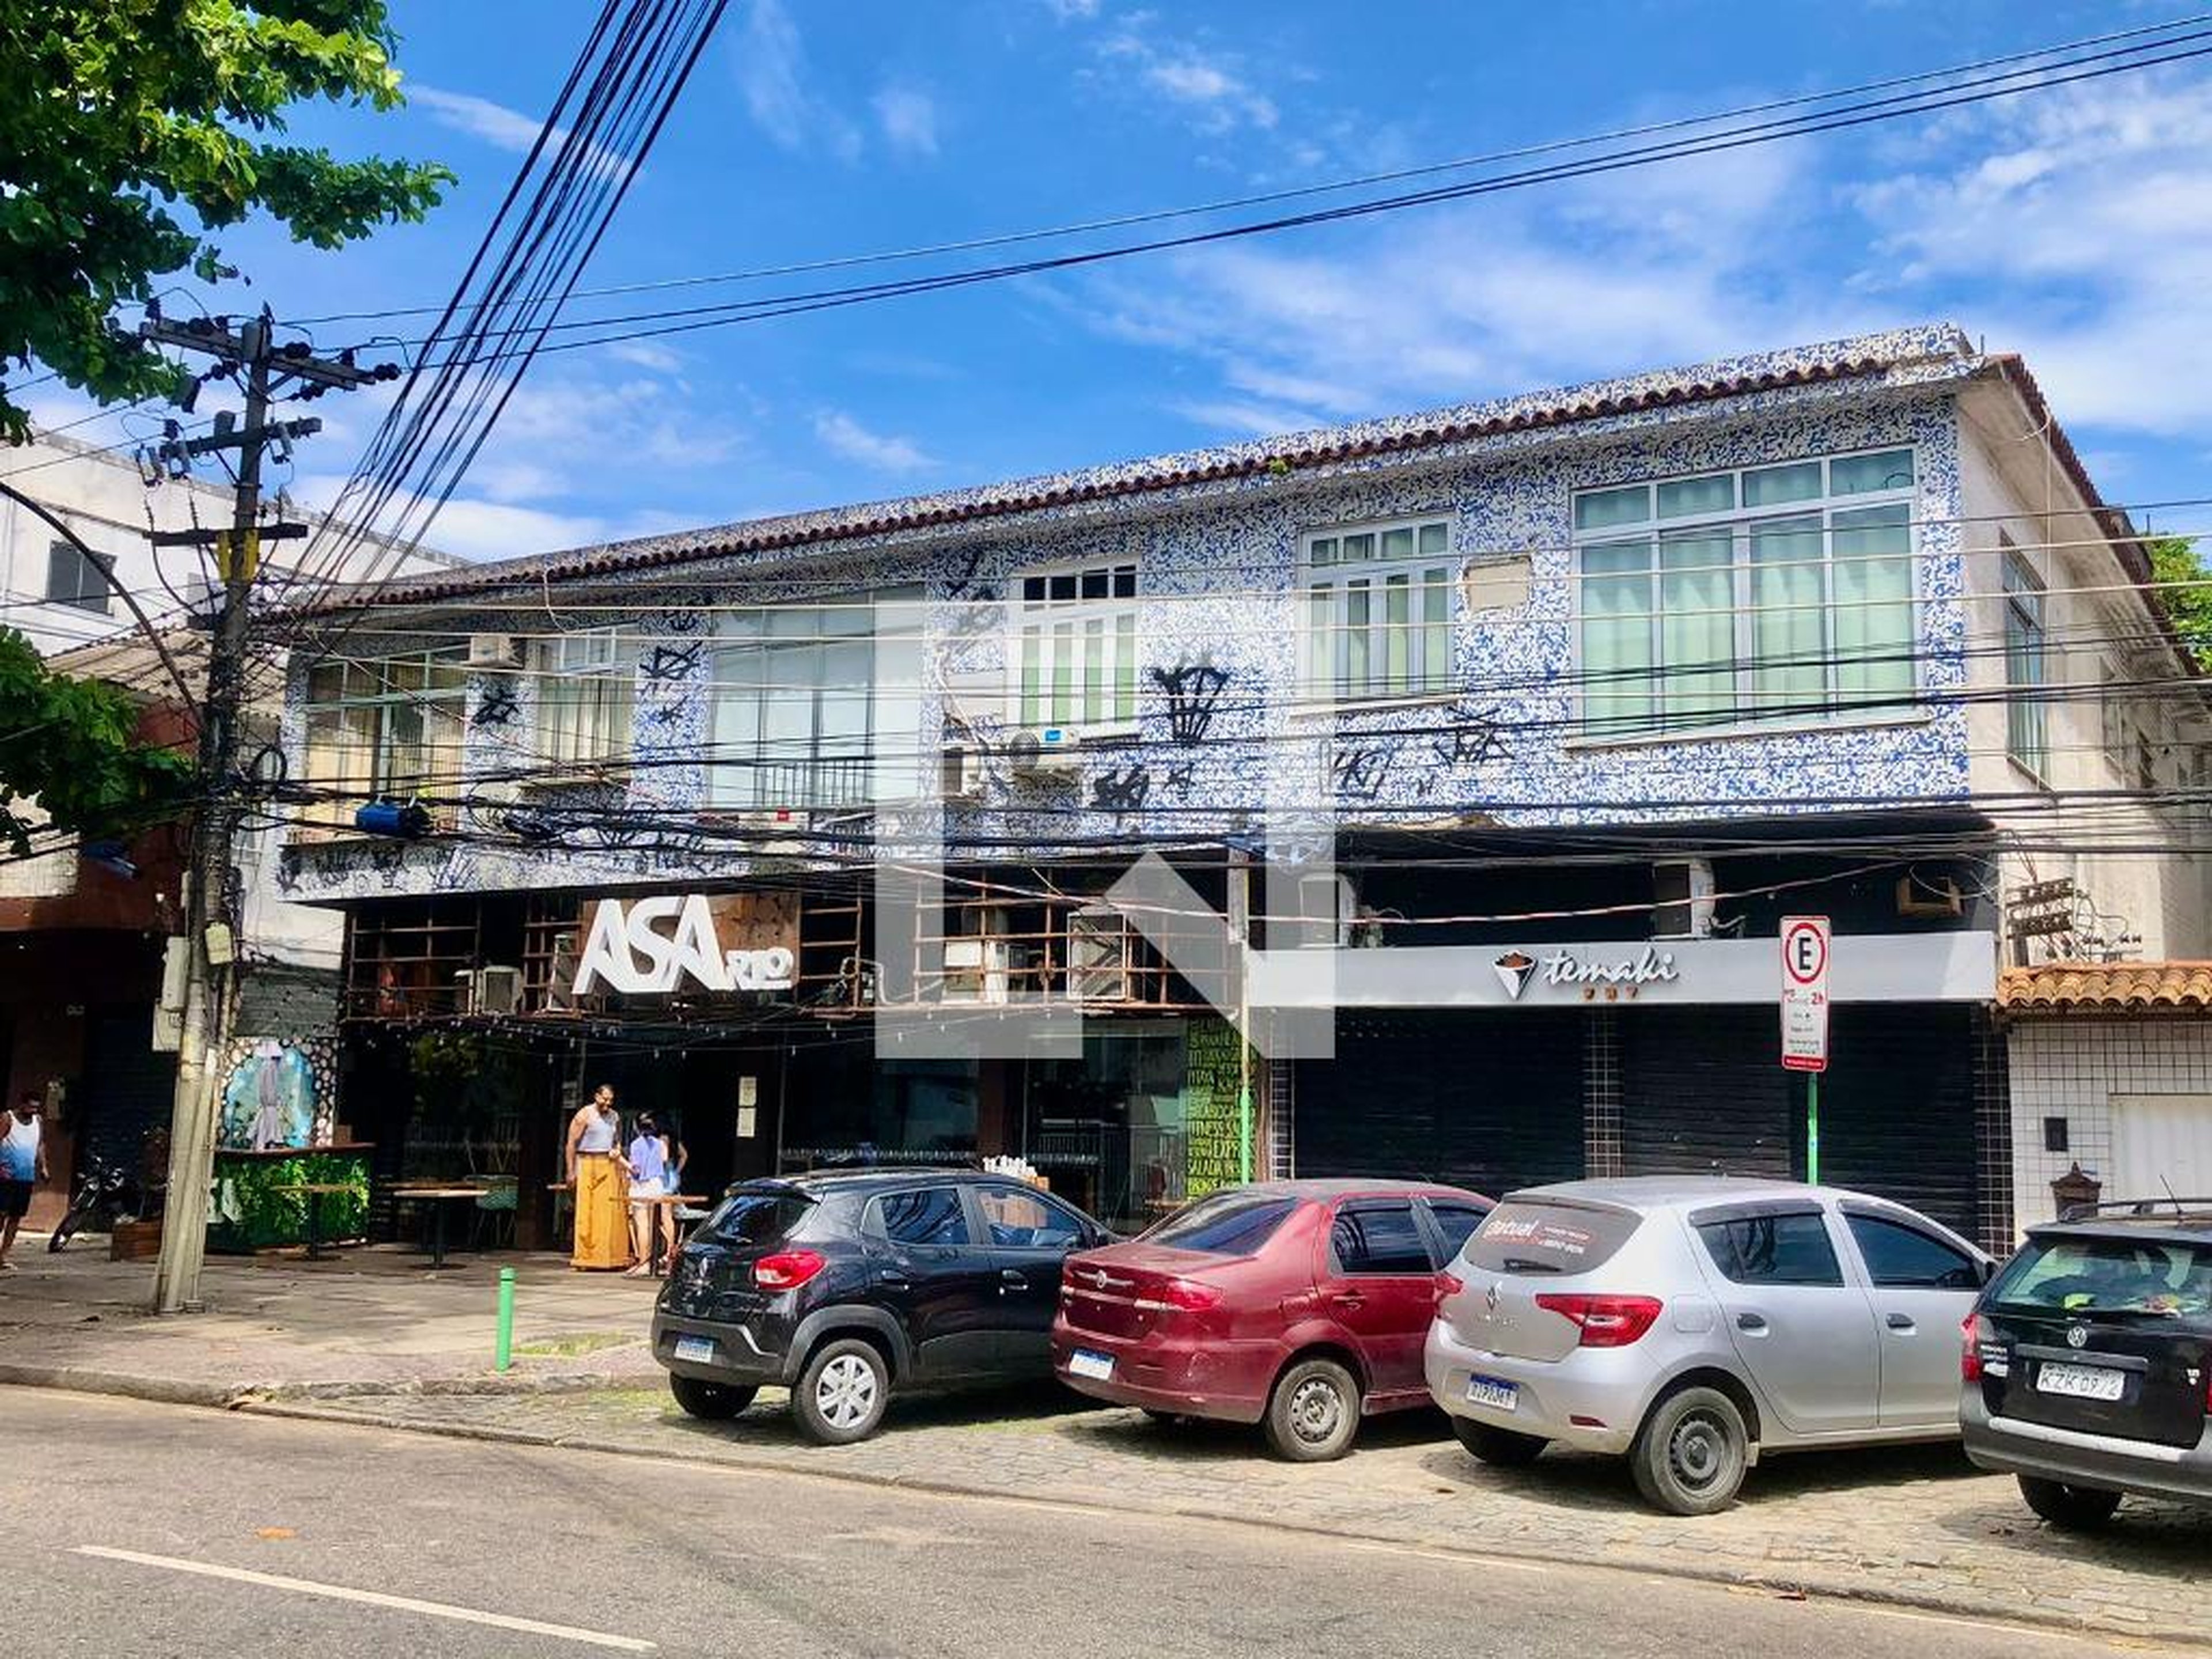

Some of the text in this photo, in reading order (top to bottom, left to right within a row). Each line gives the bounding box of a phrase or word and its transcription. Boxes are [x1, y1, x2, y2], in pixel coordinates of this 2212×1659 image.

[571, 894, 735, 994] ASA
[1798, 937, 1812, 971] E
[1541, 946, 1679, 985] temaki
